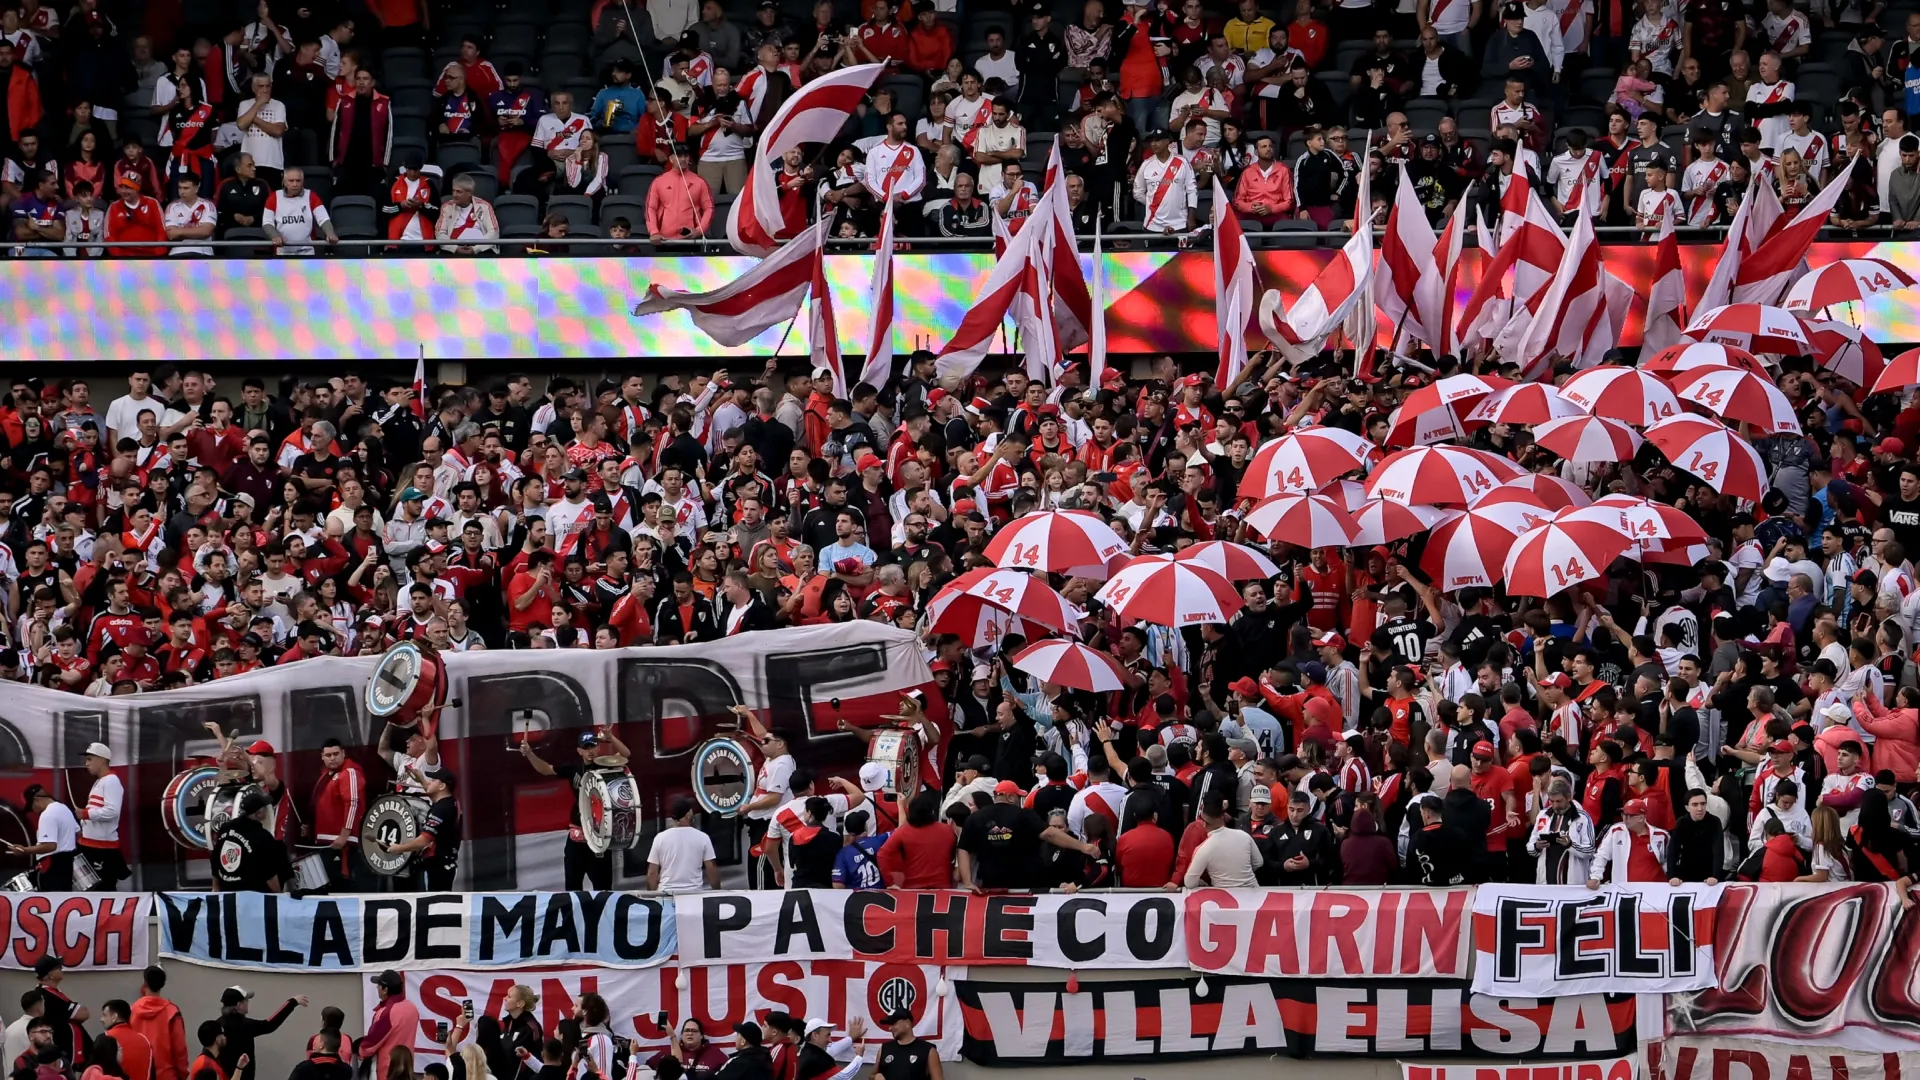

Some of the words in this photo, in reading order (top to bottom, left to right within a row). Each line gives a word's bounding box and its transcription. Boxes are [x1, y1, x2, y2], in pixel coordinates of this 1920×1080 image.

[175, 120, 204, 129] codere
[281, 215, 305, 225] BBVA
[1860, 271, 1891, 293] 14
[1694, 313, 1716, 329] 14
[1694, 382, 1725, 406] 14
[1478, 400, 1501, 418] 14
[1649, 401, 1675, 421] 14
[1690, 451, 1719, 481] 14
[1274, 466, 1304, 492] 14
[1463, 470, 1491, 495] 14
[1630, 519, 1657, 538] 14
[1013, 543, 1040, 566] 14
[1551, 556, 1585, 587] 14
[983, 580, 1014, 604] 14
[1106, 578, 1131, 605] 14
[1388, 622, 1418, 634] QUINTERO
[1393, 632, 1422, 663] 10
[706, 751, 717, 765] ARA
[716, 749, 728, 758] SAN
[727, 751, 740, 767] JUAN
[710, 793, 718, 803] 44
[366, 809, 380, 829] LOS
[379, 800, 414, 838] BORRACHOS
[381, 825, 397, 845] 14
[370, 852, 382, 868] DEL
[857, 859, 880, 888] 10
[157, 891, 355, 967] VILLA
[363, 895, 463, 963] DE
[479, 891, 663, 961] MAYO
[702, 889, 1176, 962] PACHECO
[1184, 888, 1469, 974] GARIN
[1493, 891, 1698, 983] FELI
[419, 974, 599, 1046] SAN
[632, 958, 928, 1041] JUSTO
[977, 983, 1288, 1058] VILLA
[1314, 987, 1618, 1055] ELISA
